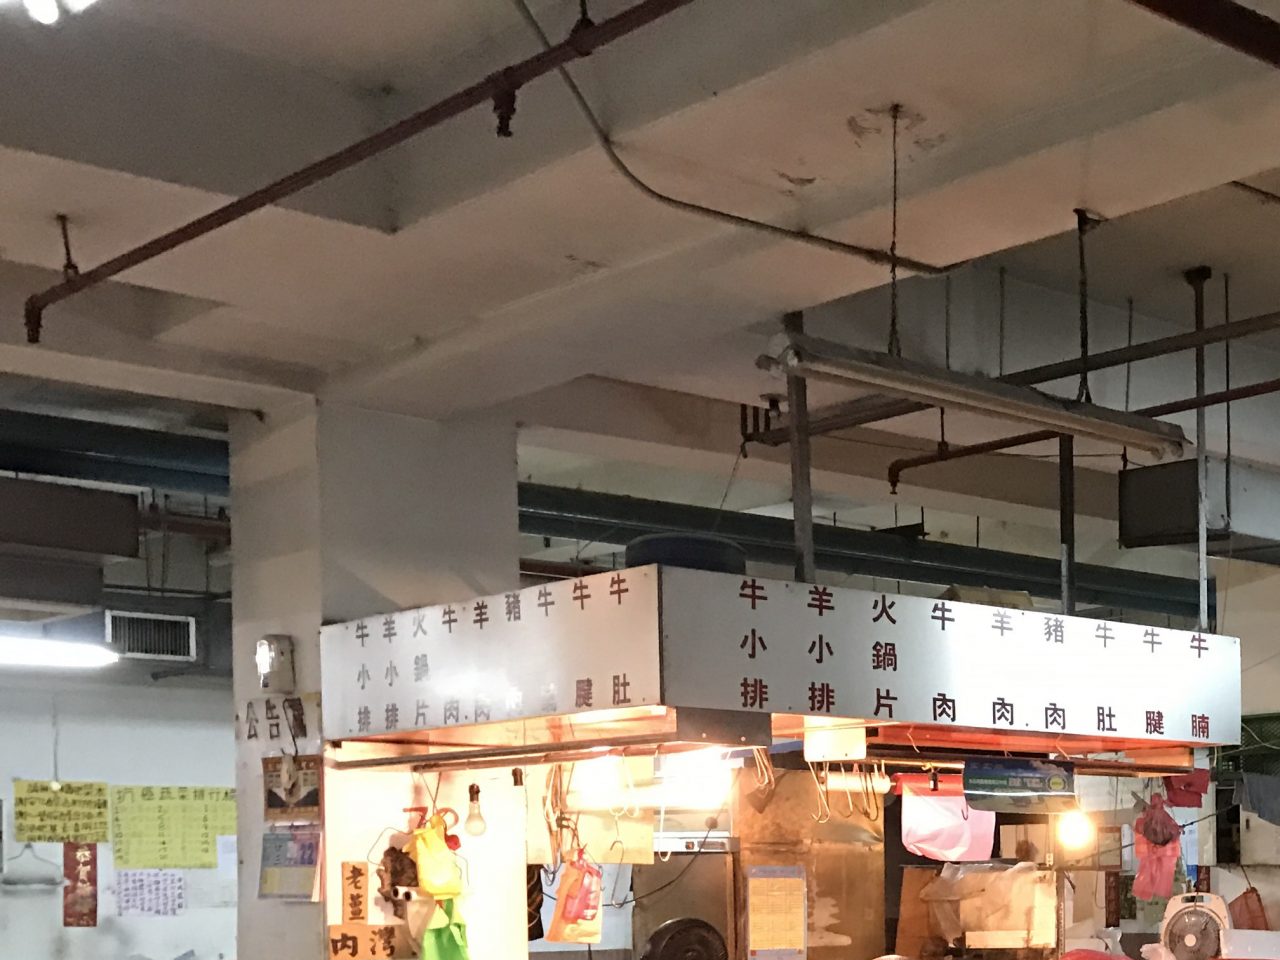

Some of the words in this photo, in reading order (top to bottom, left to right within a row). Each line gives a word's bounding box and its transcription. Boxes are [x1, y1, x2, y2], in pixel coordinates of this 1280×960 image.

[739, 577, 769, 711] 牛小排
[806, 585, 836, 714] 羊小排
[871, 594, 899, 719] 火鍋片
